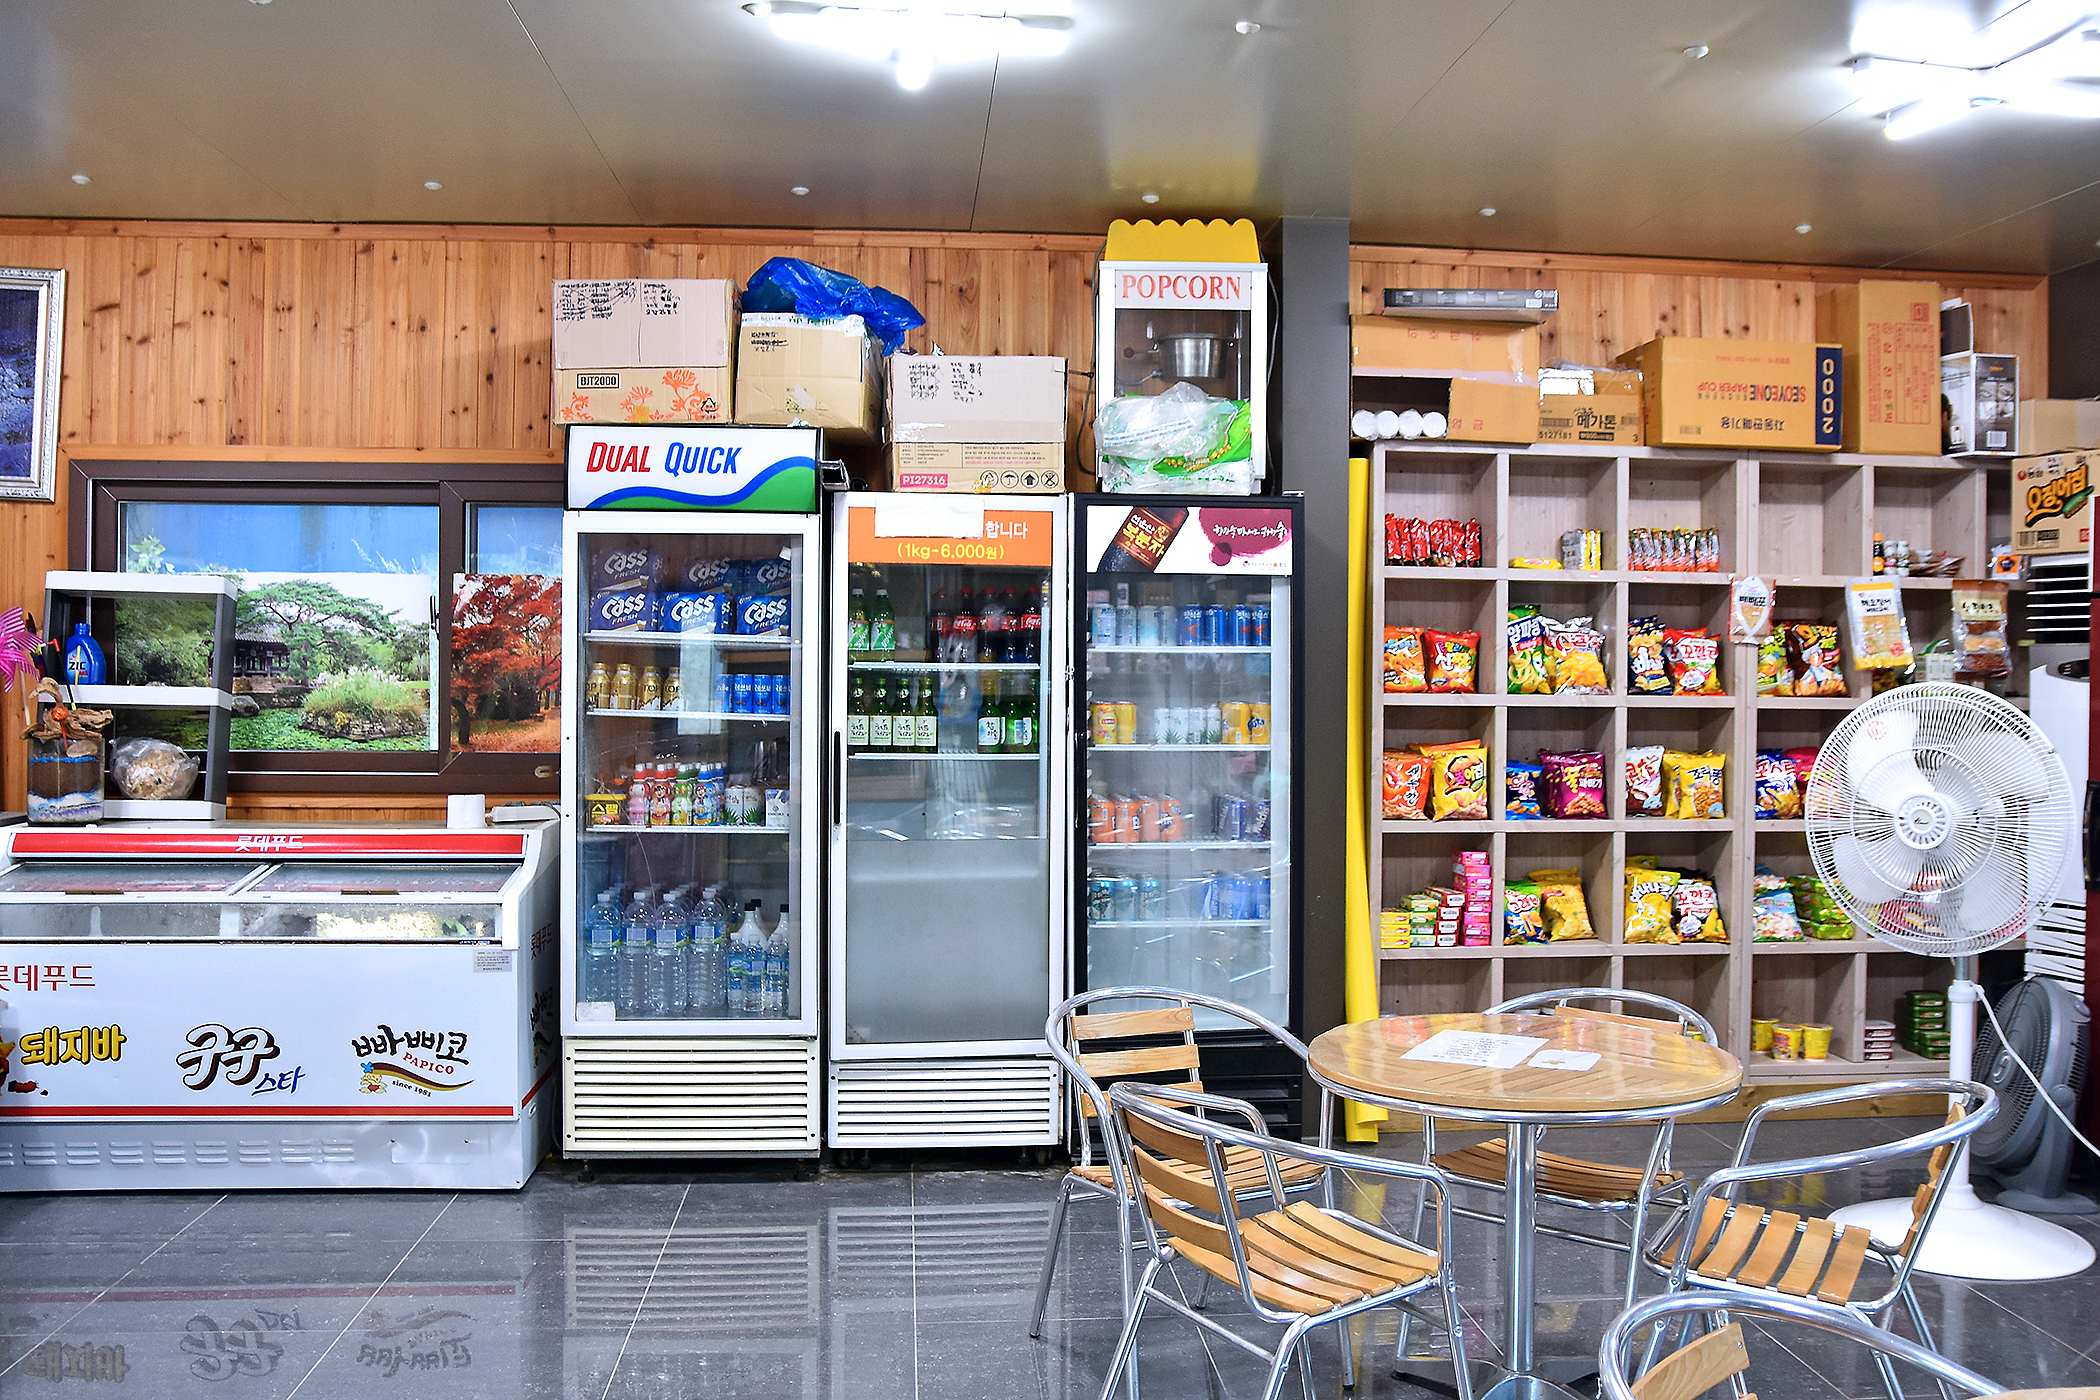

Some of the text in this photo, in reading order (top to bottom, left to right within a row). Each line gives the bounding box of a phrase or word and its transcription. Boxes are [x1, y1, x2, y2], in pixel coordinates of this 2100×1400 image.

[1121, 274, 1241, 300] POPCORN
[586, 441, 742, 477] DUAL QUICK
[902, 475, 946, 486] PI27316
[68, 662, 87, 671] ZIC
[236, 835, 304, 852] 롯데푸드
[20, 1024, 127, 1066] 돼지바
[351, 1024, 469, 1066] 빠삐코
[403, 1051, 454, 1075] PAPICO
[392, 1079, 432, 1098] since 1981
